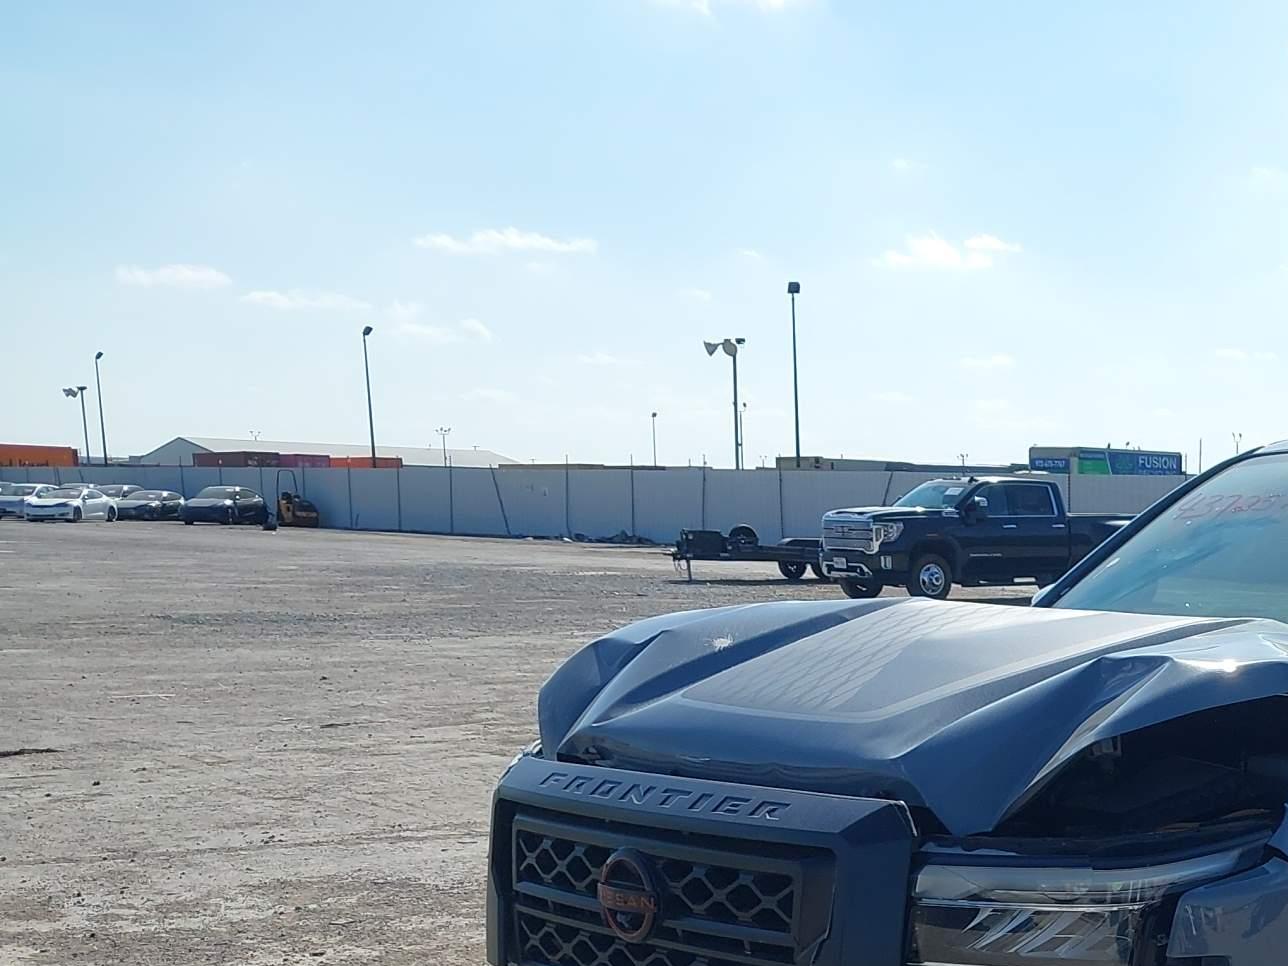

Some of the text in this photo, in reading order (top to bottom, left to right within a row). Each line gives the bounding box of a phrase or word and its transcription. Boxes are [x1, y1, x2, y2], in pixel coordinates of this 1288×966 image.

[1138, 456, 1177, 469] FUSION
[539, 772, 792, 821] FRONTIER
[600, 888, 656, 911] SSAN
